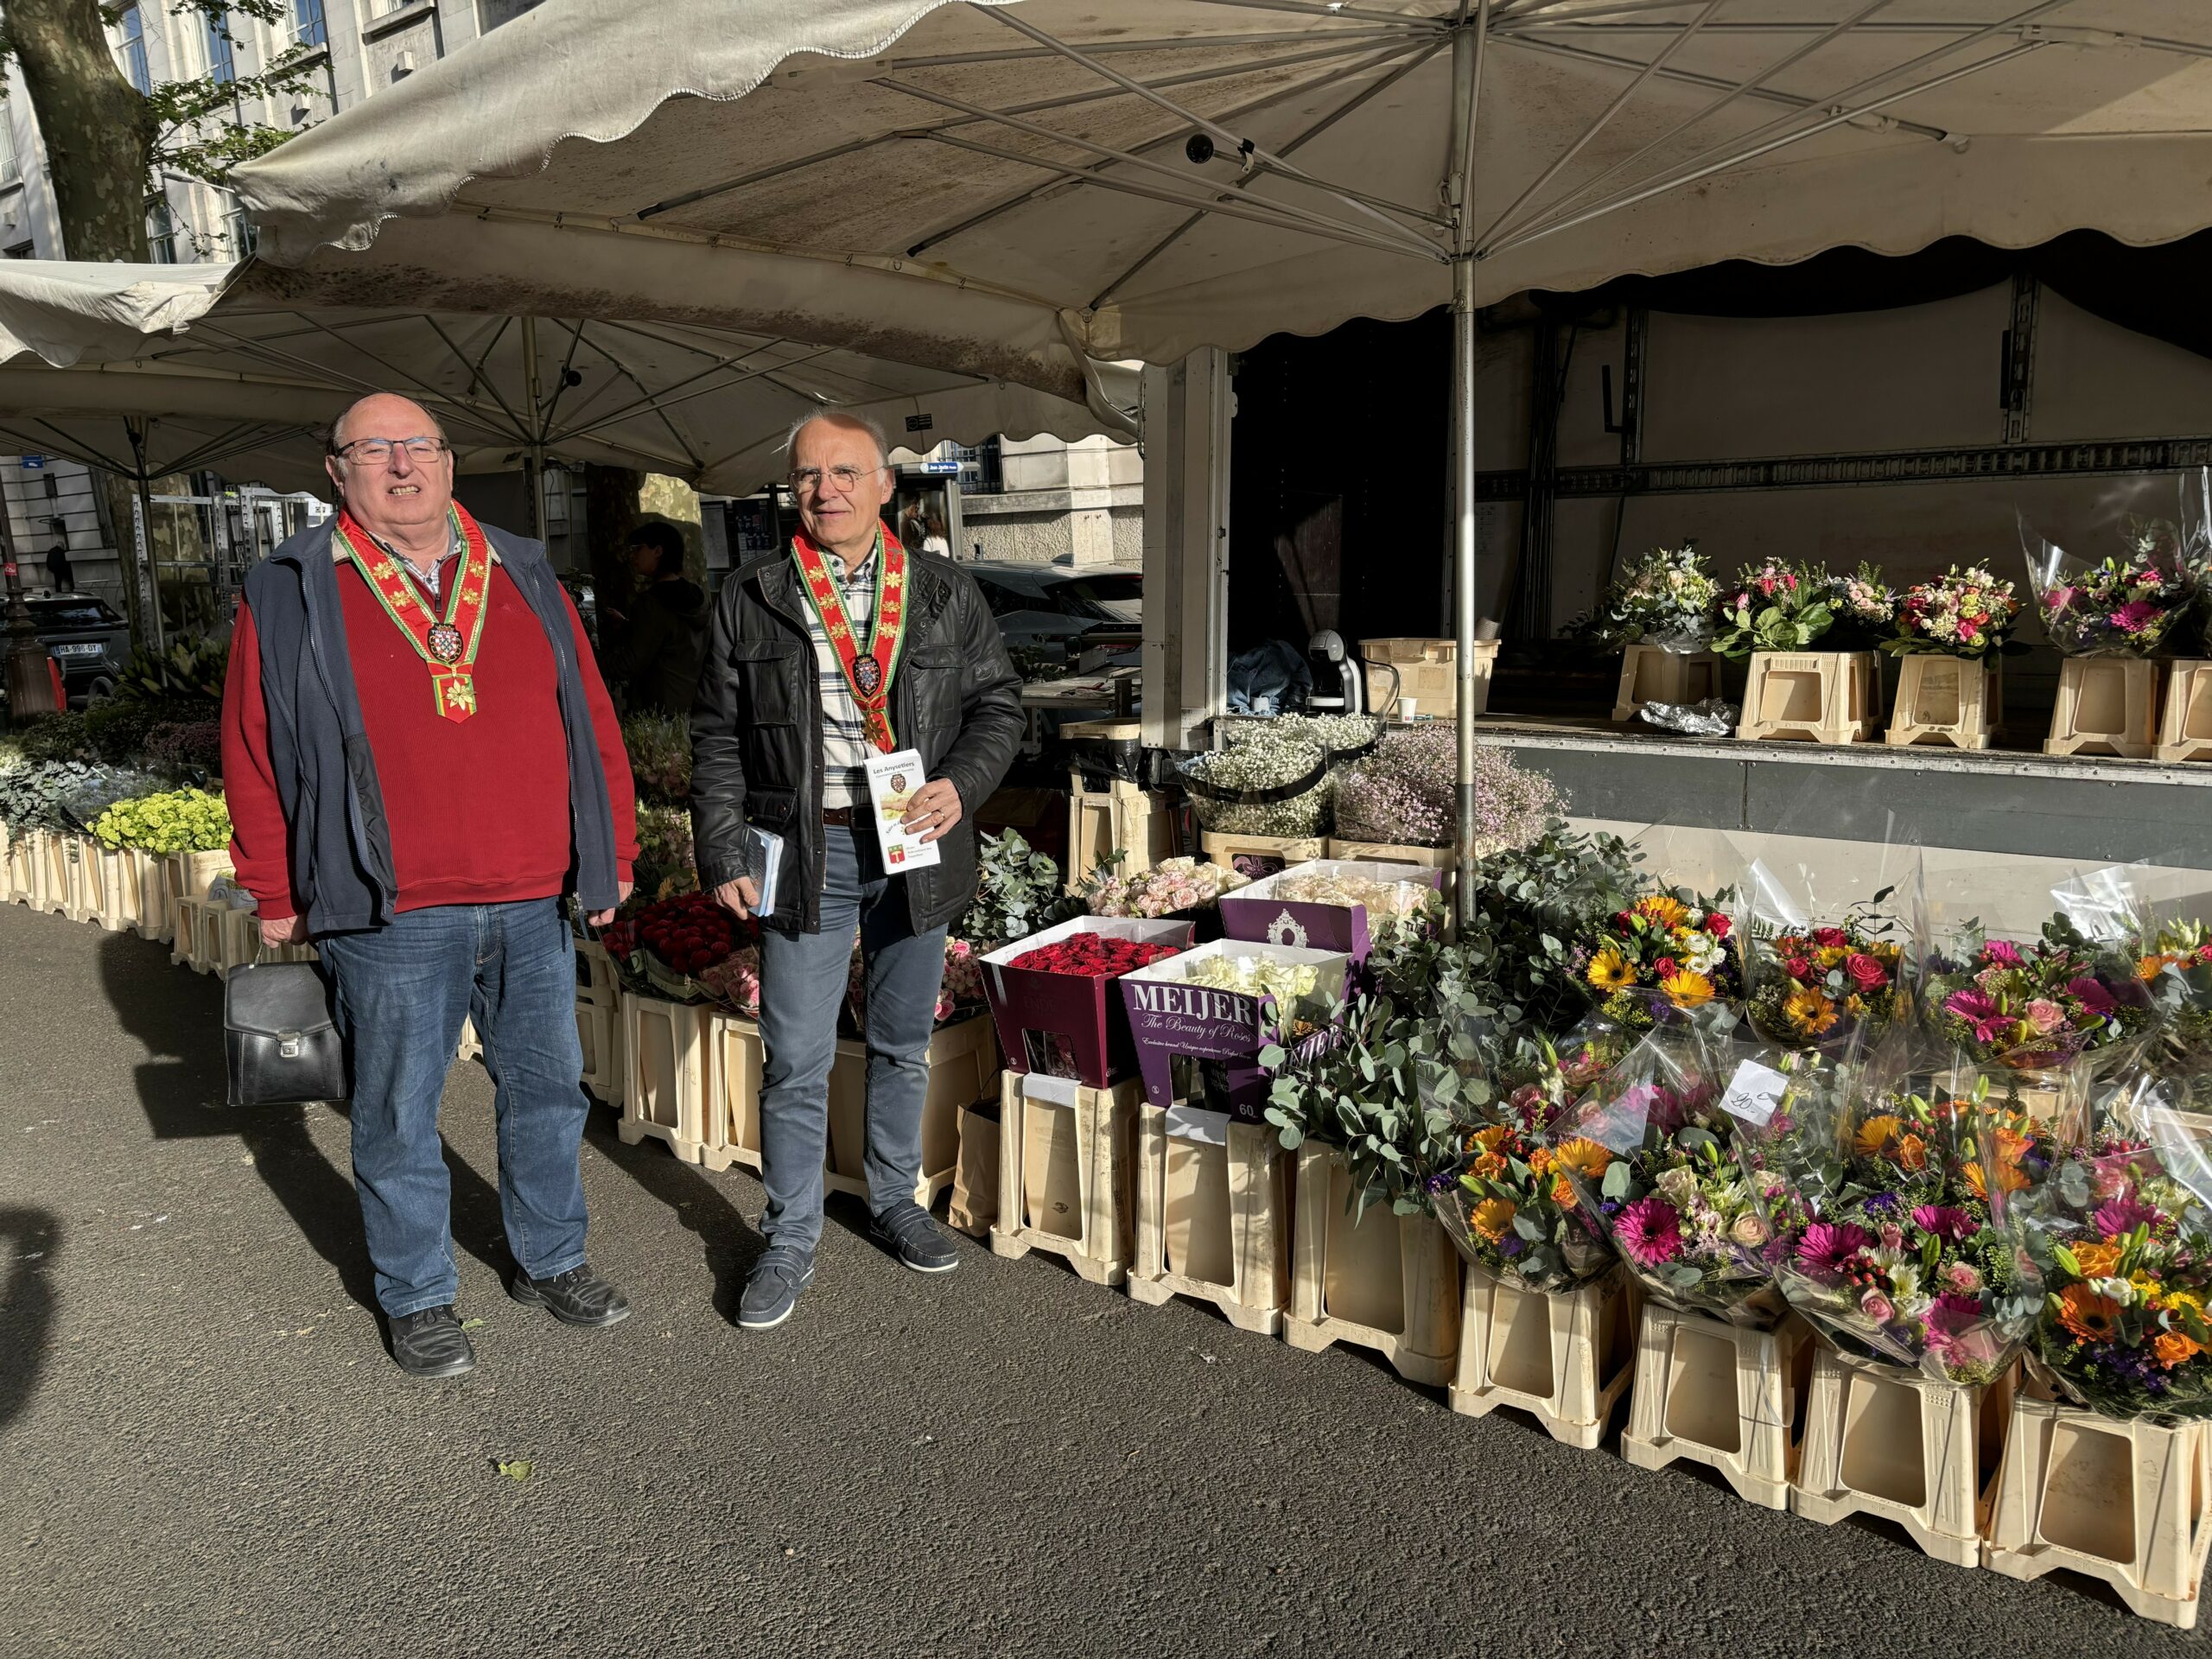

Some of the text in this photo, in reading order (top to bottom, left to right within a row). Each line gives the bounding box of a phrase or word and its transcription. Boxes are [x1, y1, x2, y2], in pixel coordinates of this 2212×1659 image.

[1131, 984, 1254, 1027] MEIJER
[1141, 1013, 1251, 1042] The Beauty of Roses
[1238, 1103, 1254, 1116] 60
